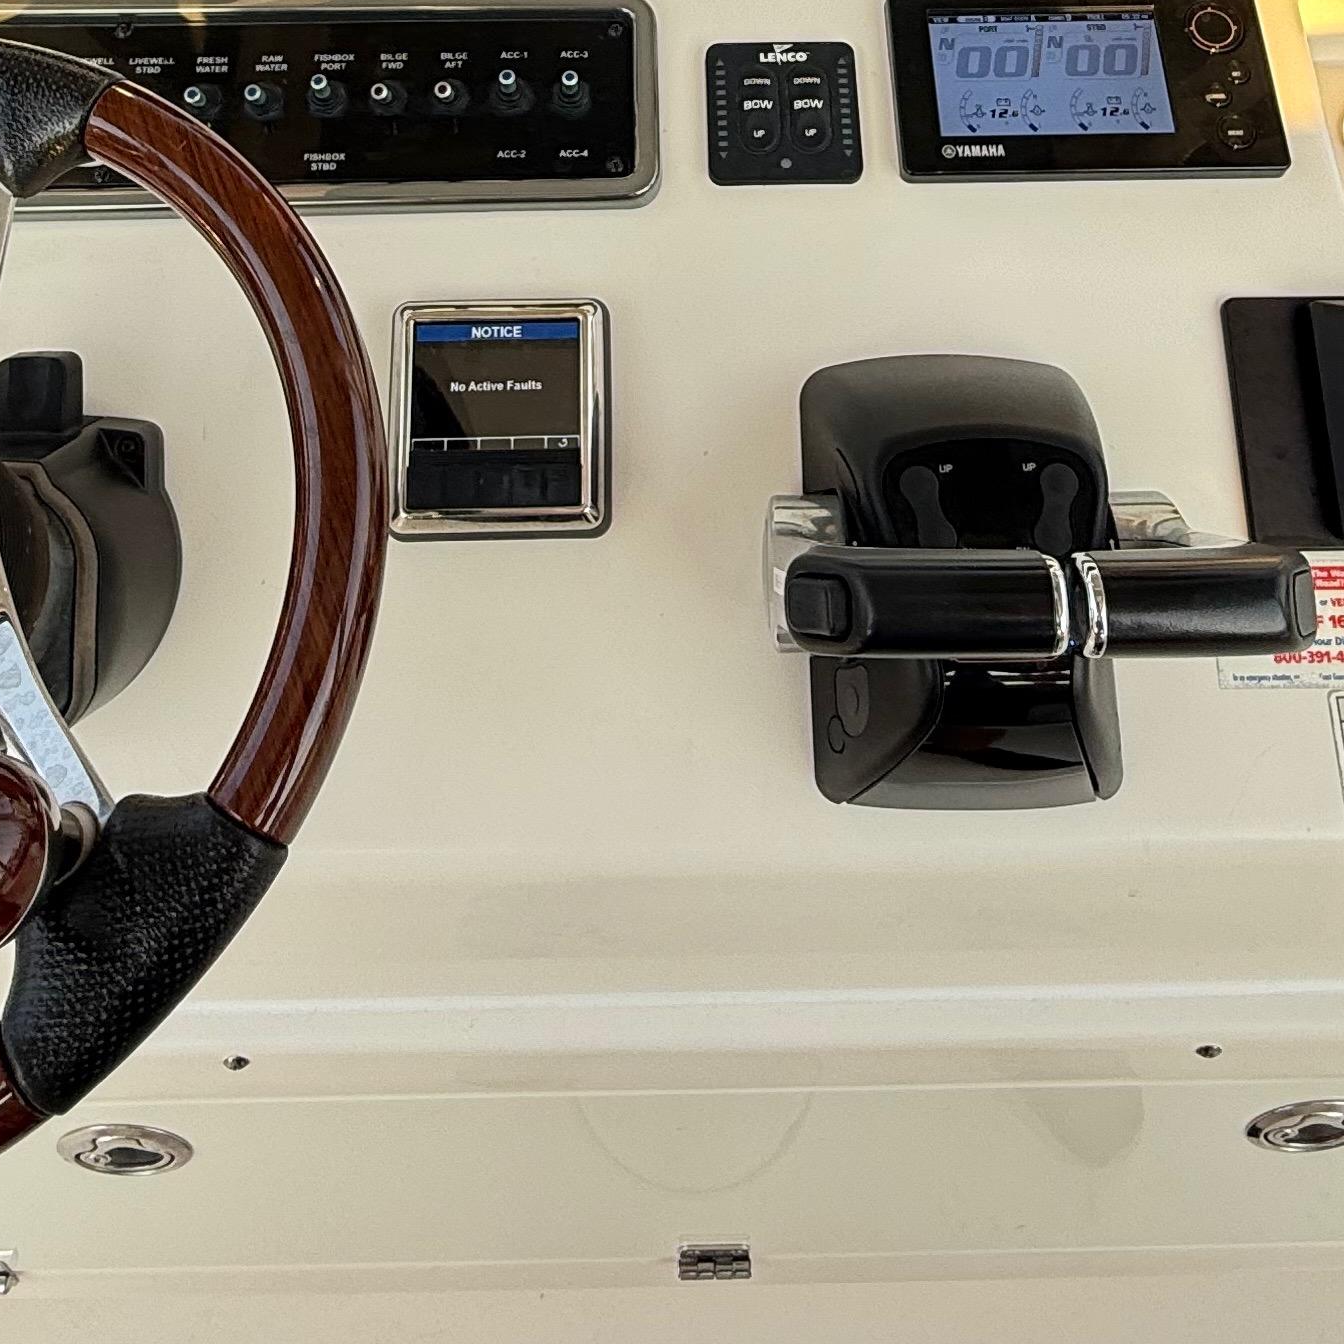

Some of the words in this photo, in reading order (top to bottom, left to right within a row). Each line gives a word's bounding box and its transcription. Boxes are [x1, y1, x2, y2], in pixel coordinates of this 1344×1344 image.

[939, 38, 955, 50] N
[1047, 36, 1063, 48] N
[760, 52, 807, 64] LENCO
[744, 100, 773, 110] BOW
[794, 99, 823, 109] BOW
[956, 145, 1005, 156] YAMAHA
[471, 326, 522, 338] NOTICE
[451, 382, 465, 392] No
[468, 381, 503, 391] Active
[507, 380, 542, 390] Faults
[939, 464, 953, 472] UP
[1022, 463, 1036, 471] UP
